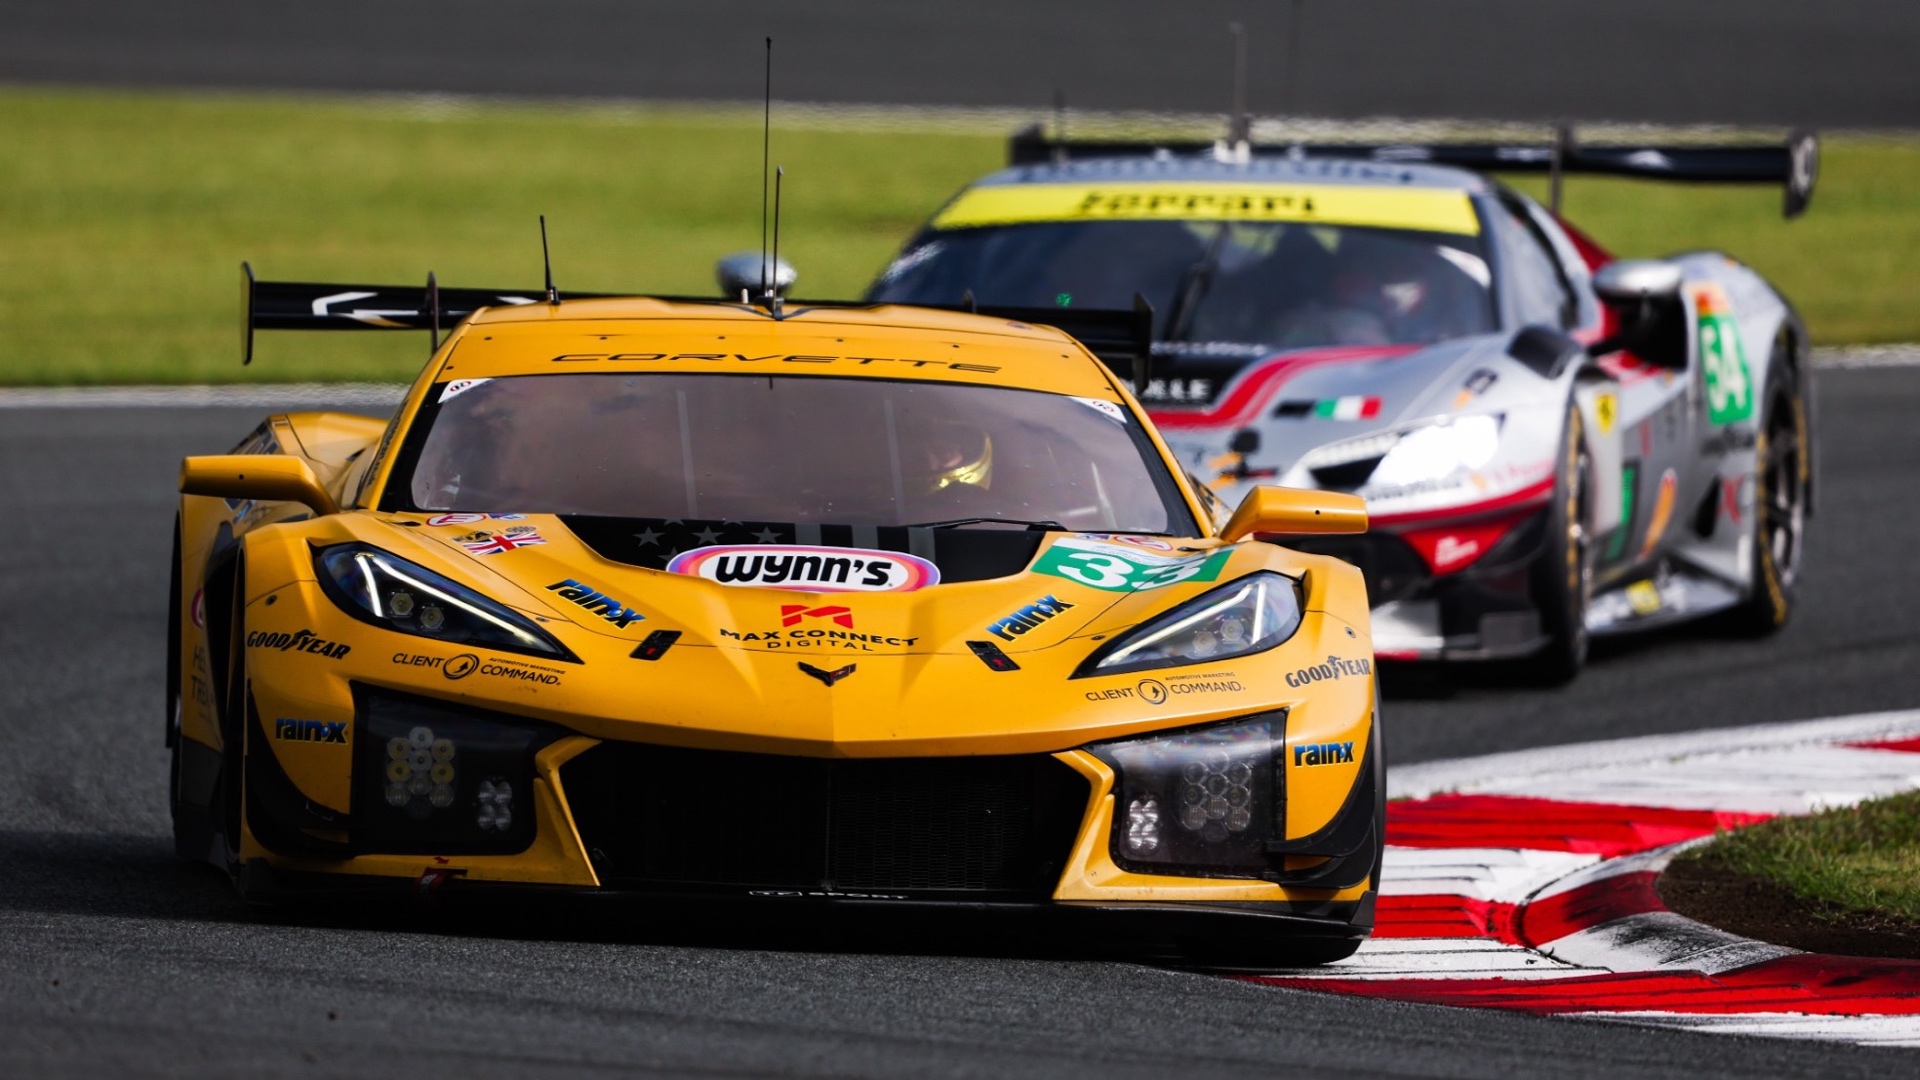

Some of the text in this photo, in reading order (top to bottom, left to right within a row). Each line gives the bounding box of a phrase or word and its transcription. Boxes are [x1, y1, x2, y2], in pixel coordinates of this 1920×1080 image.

[551, 352, 1003, 374] CORVETTE
[1057, 552, 1205, 589] 33
[247, 629, 351, 661] GOODYEAR
[720, 628, 919, 646] MAX CONNECT
[767, 639, 874, 652] DIGITAL
[393, 653, 561, 685] CLIENT COMMAND
[1285, 655, 1371, 688] GOODYEAR
[1086, 681, 1246, 702] CLIENT COMMAND
